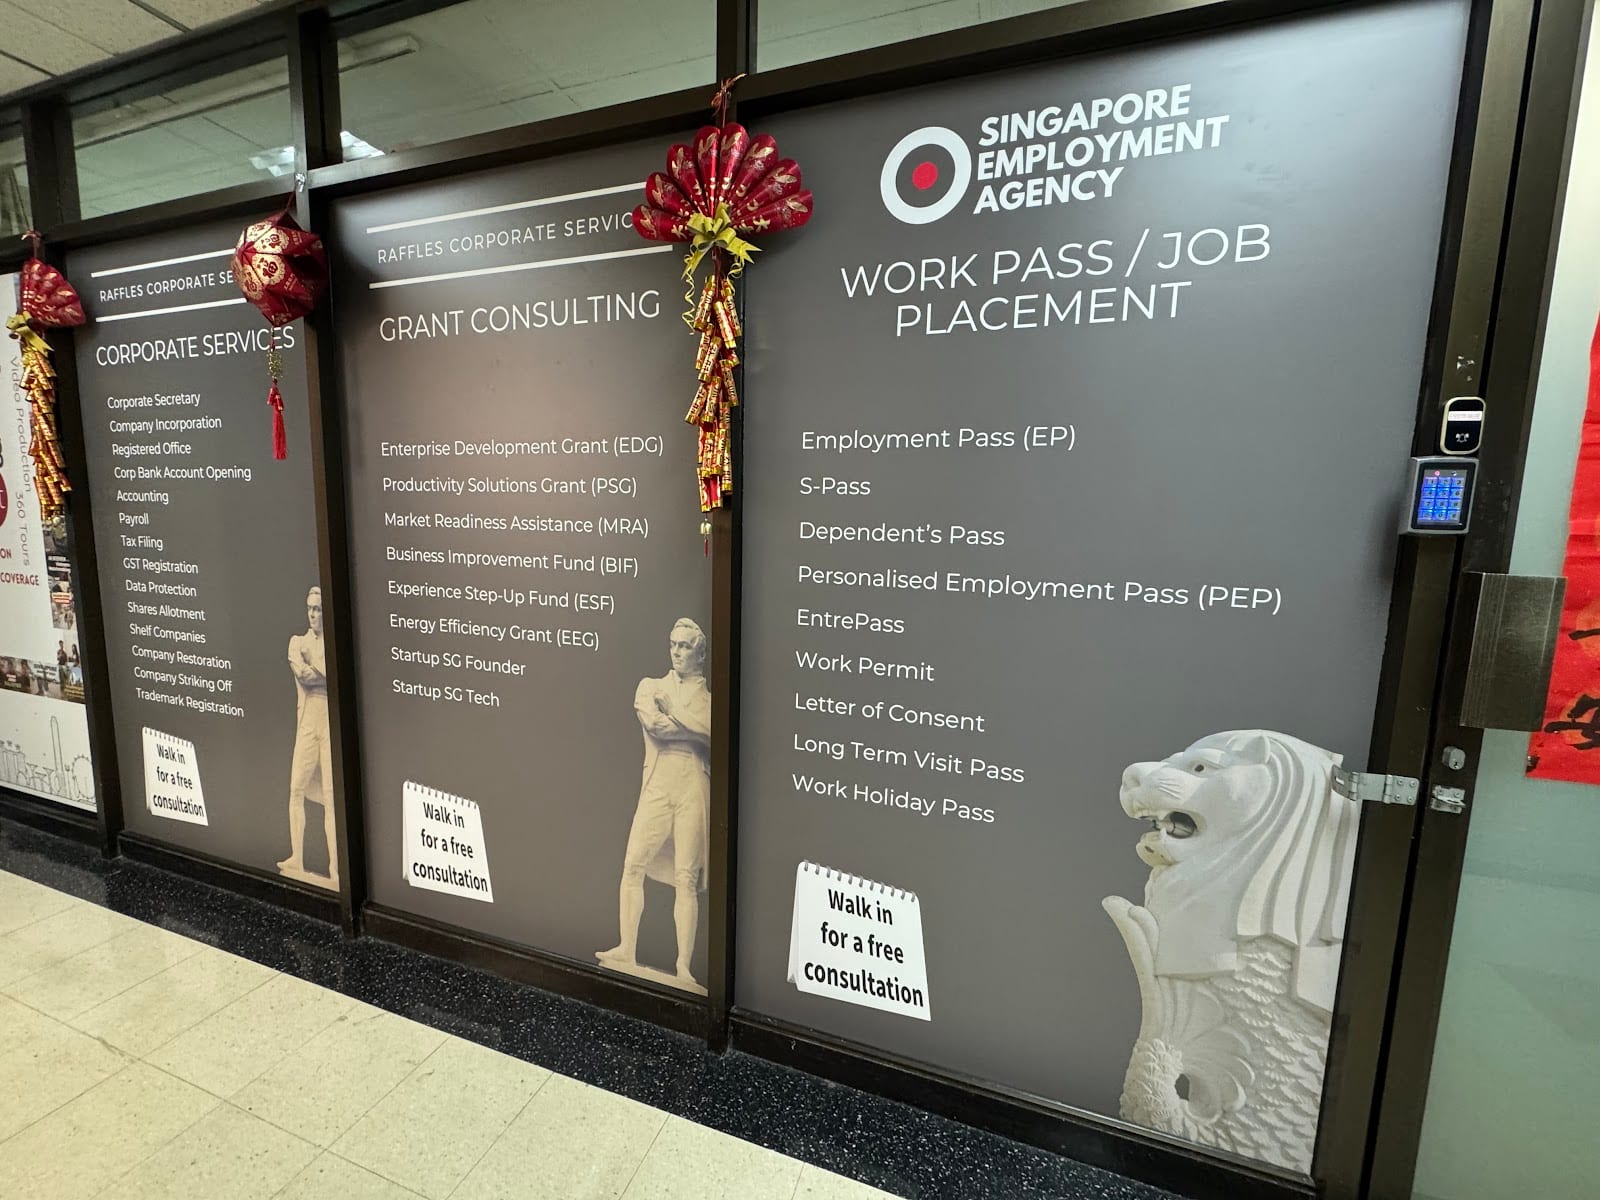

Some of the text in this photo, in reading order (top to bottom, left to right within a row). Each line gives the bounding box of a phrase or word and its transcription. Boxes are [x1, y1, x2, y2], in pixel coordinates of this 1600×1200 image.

[979, 84, 1191, 146] SINGAPORE
[977, 115, 1229, 181] EMPLOYMENT
[973, 167, 1124, 214] AGENCY
[378, 212, 632, 264] RAFFLES CORPORATE SERVIC
[841, 224, 1270, 297] WORK PASS / JOB
[99, 281, 143, 302] RAFFLES
[147, 273, 215, 295] CORPORATE
[380, 310, 464, 341] GRANT
[471, 291, 659, 333] CONSULTING
[895, 281, 1192, 336] PLACEMENT
[97, 326, 294, 365] CORPORATE SERVICES
[108, 394, 200, 410] Corporate Secretary
[110, 416, 221, 434] Company Incorporation
[803, 425, 1075, 453] Employment Pass (EP)
[112, 442, 191, 458] Registered Office
[382, 436, 663, 459] Enterprise Development Grant (EDG)
[115, 466, 251, 481] Corp Bank Account Opening
[384, 477, 636, 497] Productivity Solutions Grant (PSG)
[800, 477, 870, 495] S-Pass
[15, 491, 26, 519] 360
[117, 490, 169, 505] Accounting
[119, 513, 149, 527] Payroll
[385, 513, 648, 538] Market Readiness Assistance (MRA)
[19, 525, 30, 566] Tours
[121, 535, 163, 551] Tax Filing
[950, 526, 1004, 545] Pass
[123, 558, 198, 573] GST Registration
[387, 547, 637, 577] Business Improvement Fund (BIF)
[0, 572, 40, 586] COVERAGE
[126, 580, 196, 596] Data Protection
[799, 566, 1281, 615] Personalised Employment Pass (PEP)
[128, 602, 205, 620] Shares Allotment
[389, 581, 614, 614] Experience Step-Up Fund (ESF)
[130, 624, 206, 643] Shelf Companies
[390, 614, 598, 651] Energy Efficiency Grant (EEG)
[798, 609, 904, 633] EntrePass
[132, 645, 231, 669] Company Restoration
[392, 647, 526, 675] Startup SG Founder
[796, 651, 934, 681] Work Permit
[134, 667, 232, 692] Company Striking Off
[393, 680, 499, 706] Startup SG Tech
[136, 688, 244, 717] Trademark Registration
[796, 693, 984, 732] Letter of Consent
[157, 744, 185, 764] Walk in
[795, 734, 1024, 782] Long Term Visit Pass
[157, 766, 192, 789] for a free
[152, 791, 204, 818] consultation
[793, 774, 994, 822] Work Holiday Pass
[423, 802, 464, 828] Walk in
[421, 829, 473, 858] for a free
[412, 861, 488, 892] consultation
[828, 889, 892, 925] Walk in
[821, 922, 903, 963] for a free
[804, 962, 923, 1007] consultation
